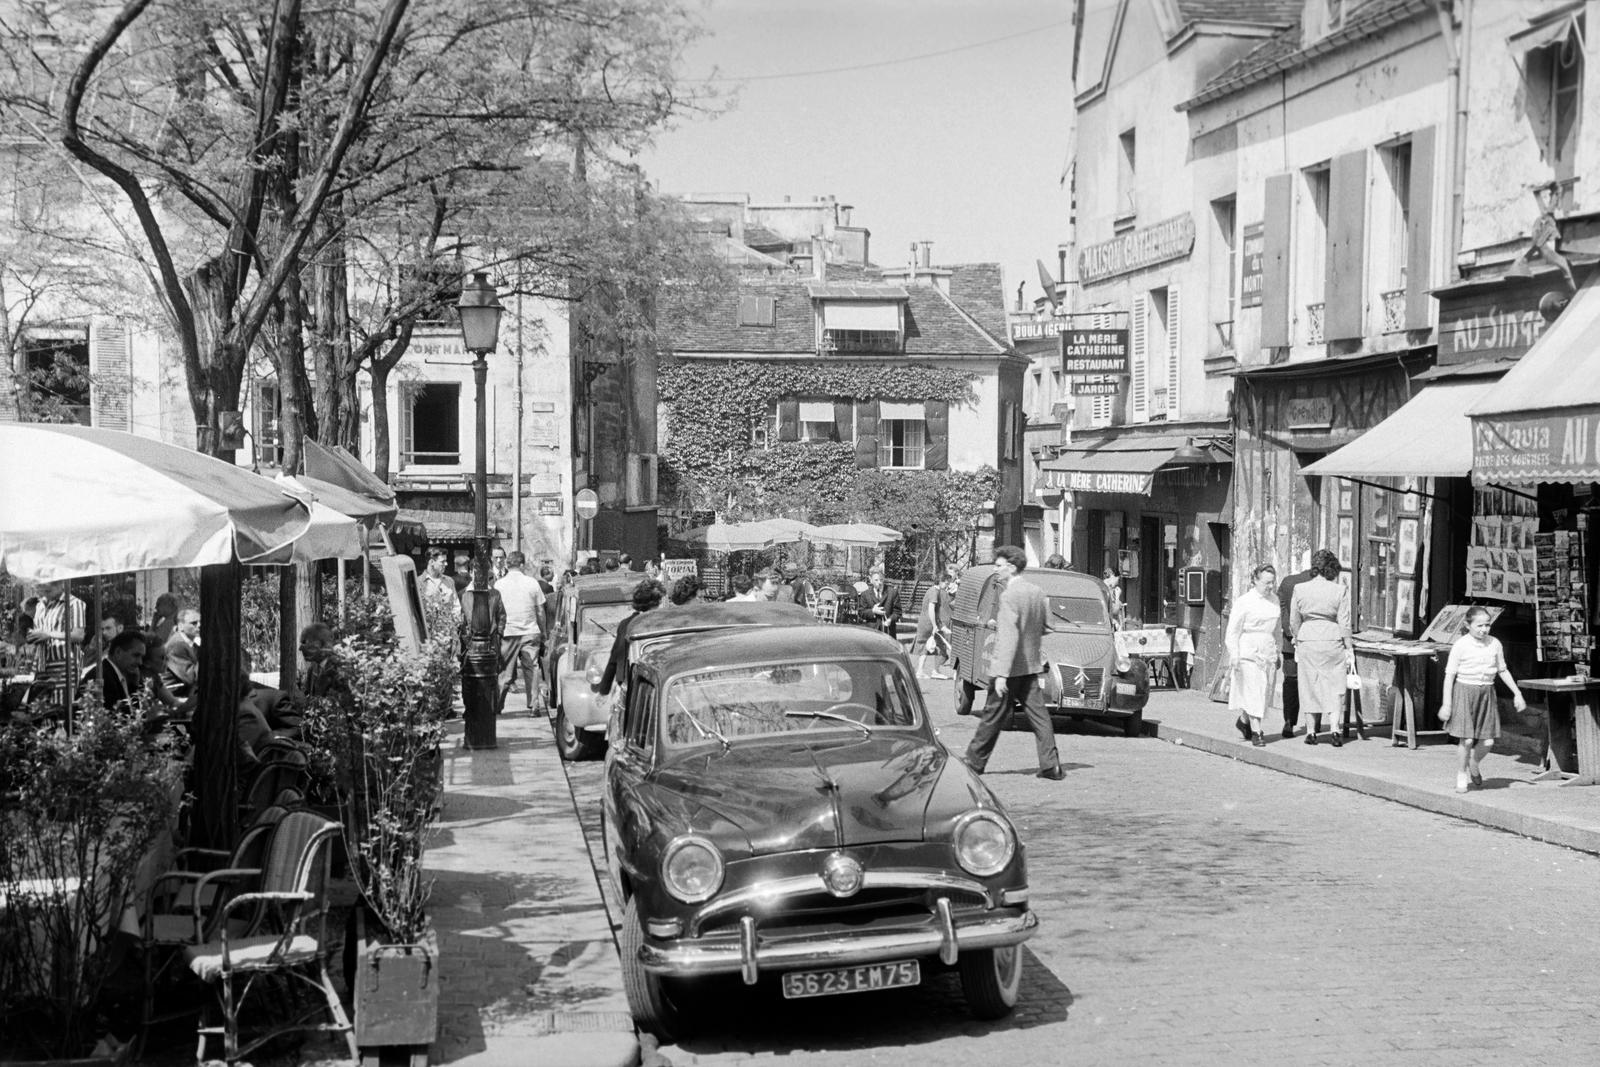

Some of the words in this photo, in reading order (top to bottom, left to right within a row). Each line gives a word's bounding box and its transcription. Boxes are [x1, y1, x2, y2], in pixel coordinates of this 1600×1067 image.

[1083, 239, 1121, 280] MAISON
[1073, 334, 1086, 345] LA
[1454, 317, 1480, 352] AU
[1067, 345, 1125, 356] CATHERINE
[1067, 359, 1125, 371] RESTAURANT
[1078, 384, 1115, 394] JARDIN
[1561, 418, 1588, 465] AU
[1057, 472, 1065, 488] LA
[1096, 473, 1146, 491] CATHERINE
